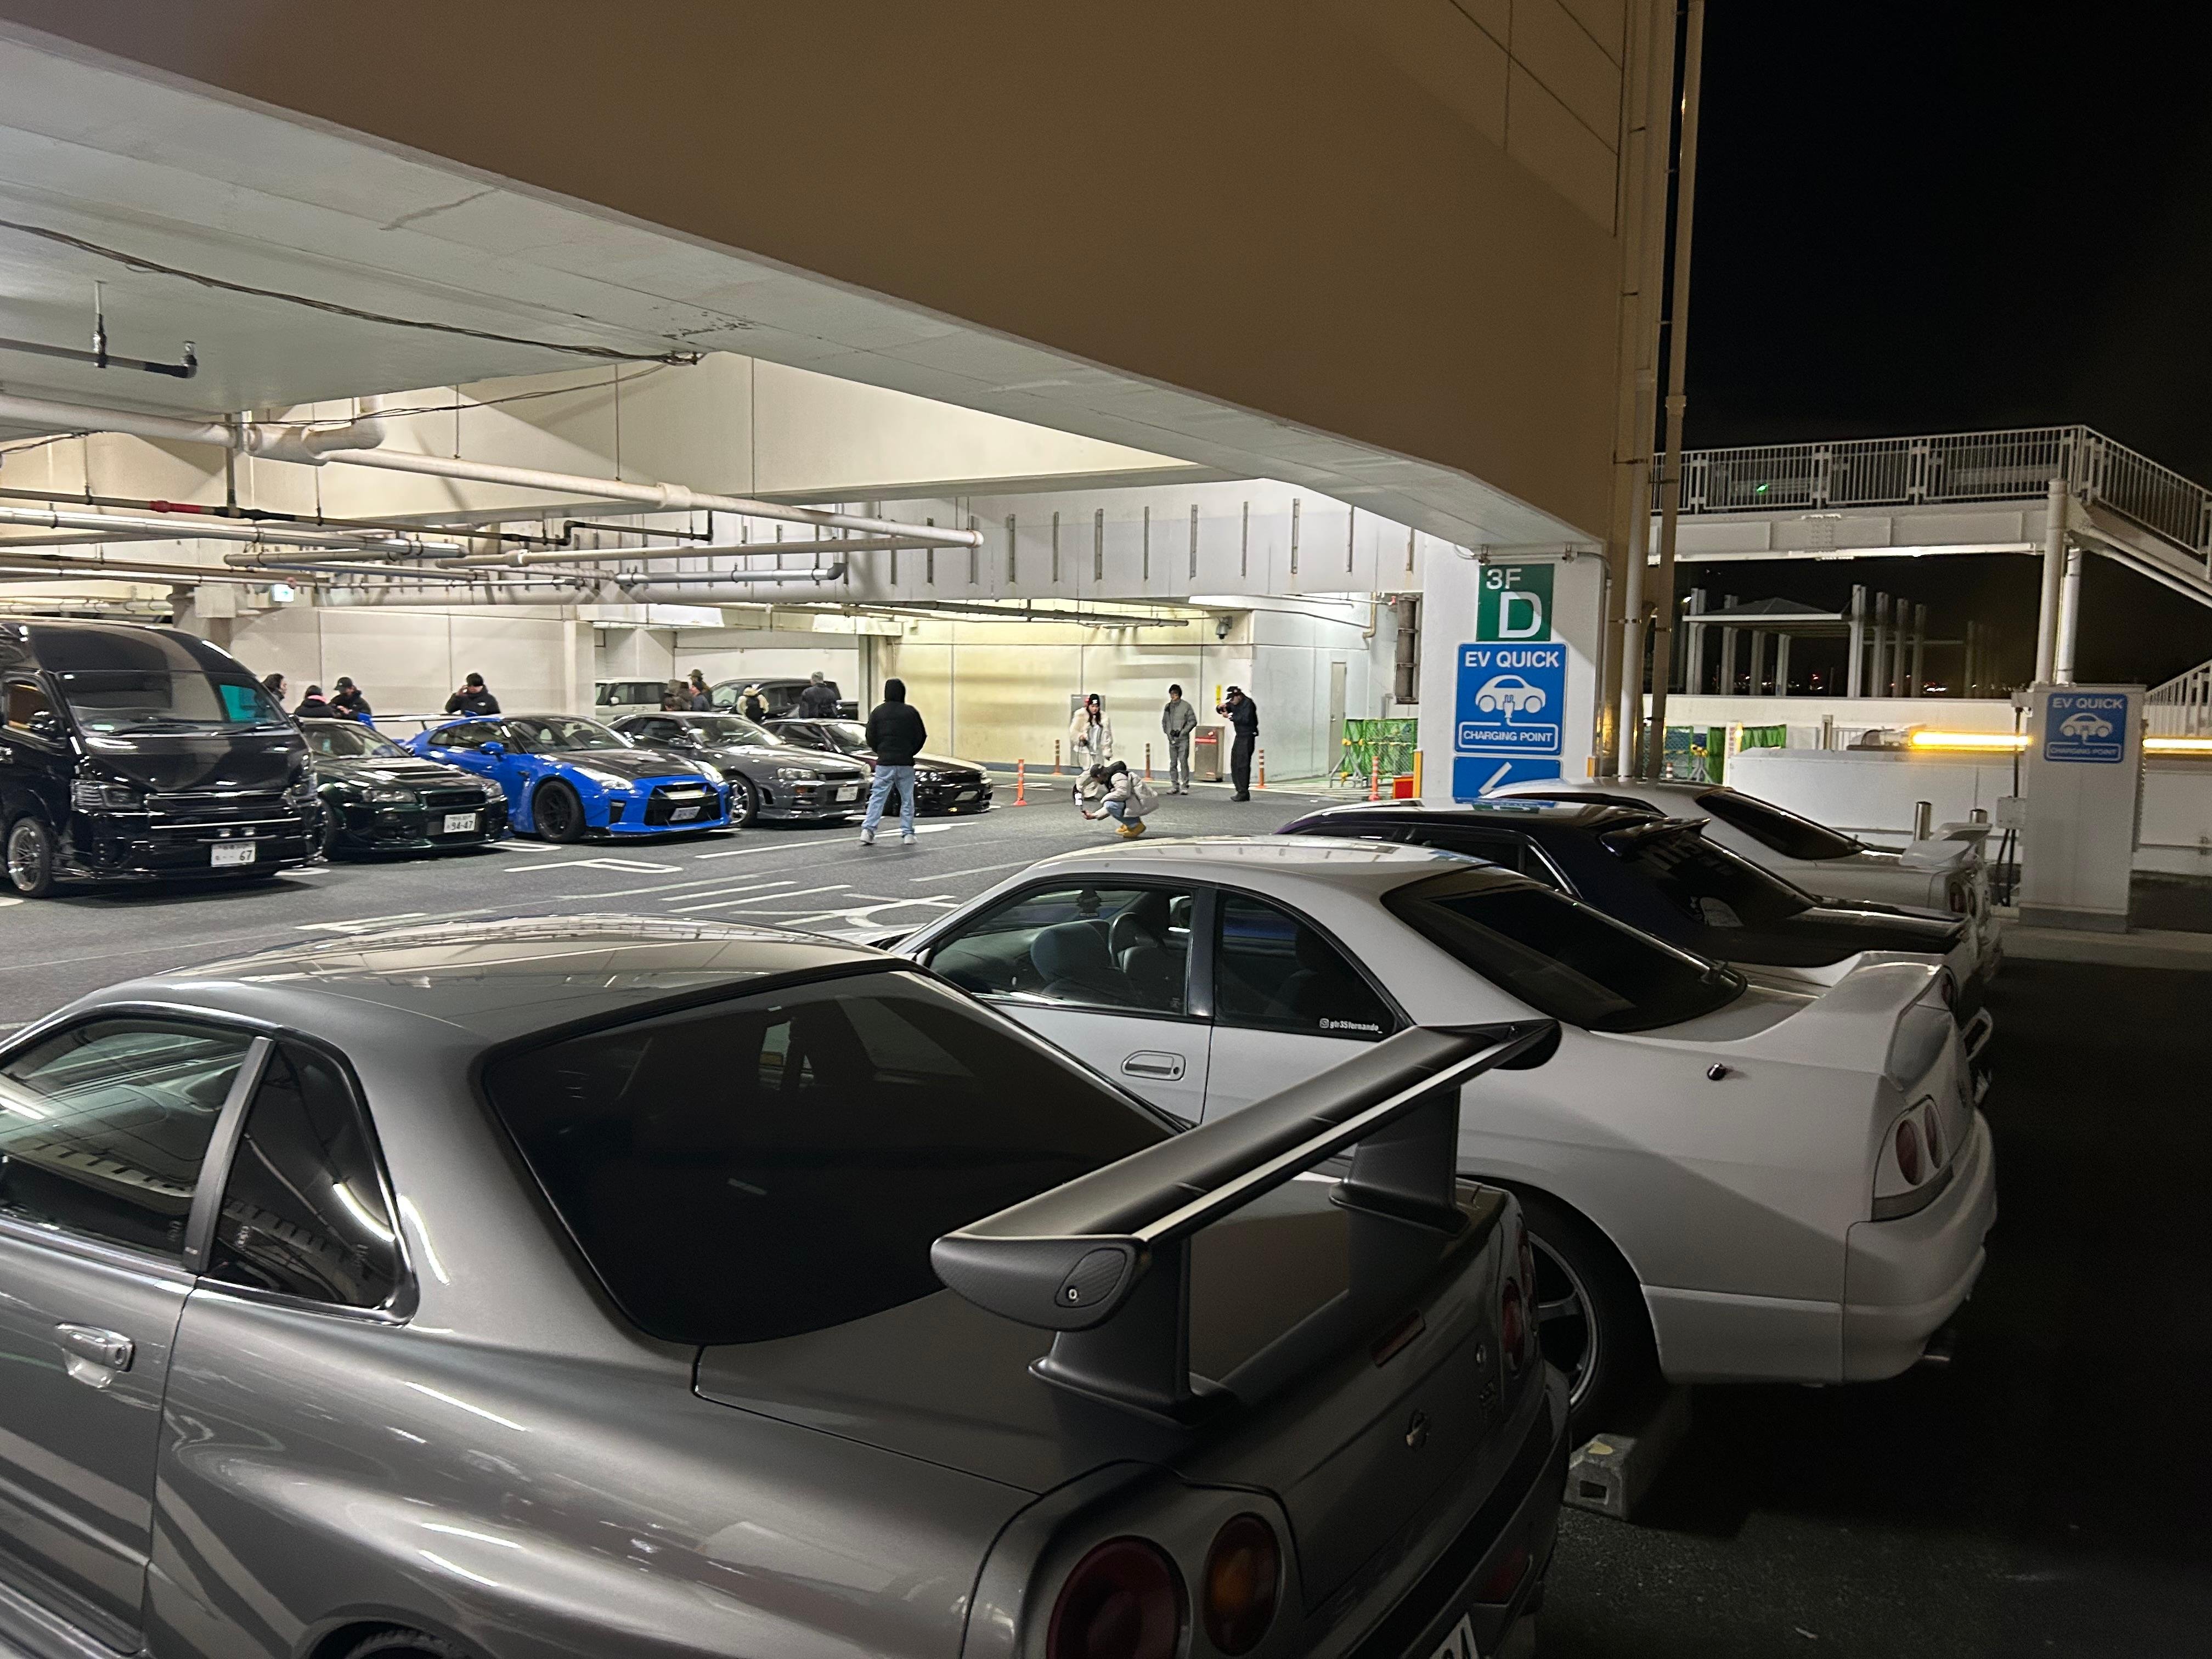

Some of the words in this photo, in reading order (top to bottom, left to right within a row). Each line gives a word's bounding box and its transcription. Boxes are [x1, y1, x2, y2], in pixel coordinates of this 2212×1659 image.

[1486, 568, 1522, 590] 3F
[1498, 591, 1543, 639] D
[1464, 651, 1491, 668] EV
[1496, 651, 1560, 668] QUICK
[2052, 697, 2073, 708] EV
[2076, 697, 2123, 709] QUICK
[1463, 730, 1517, 742] CHARGING
[1520, 731, 1553, 743] POINT
